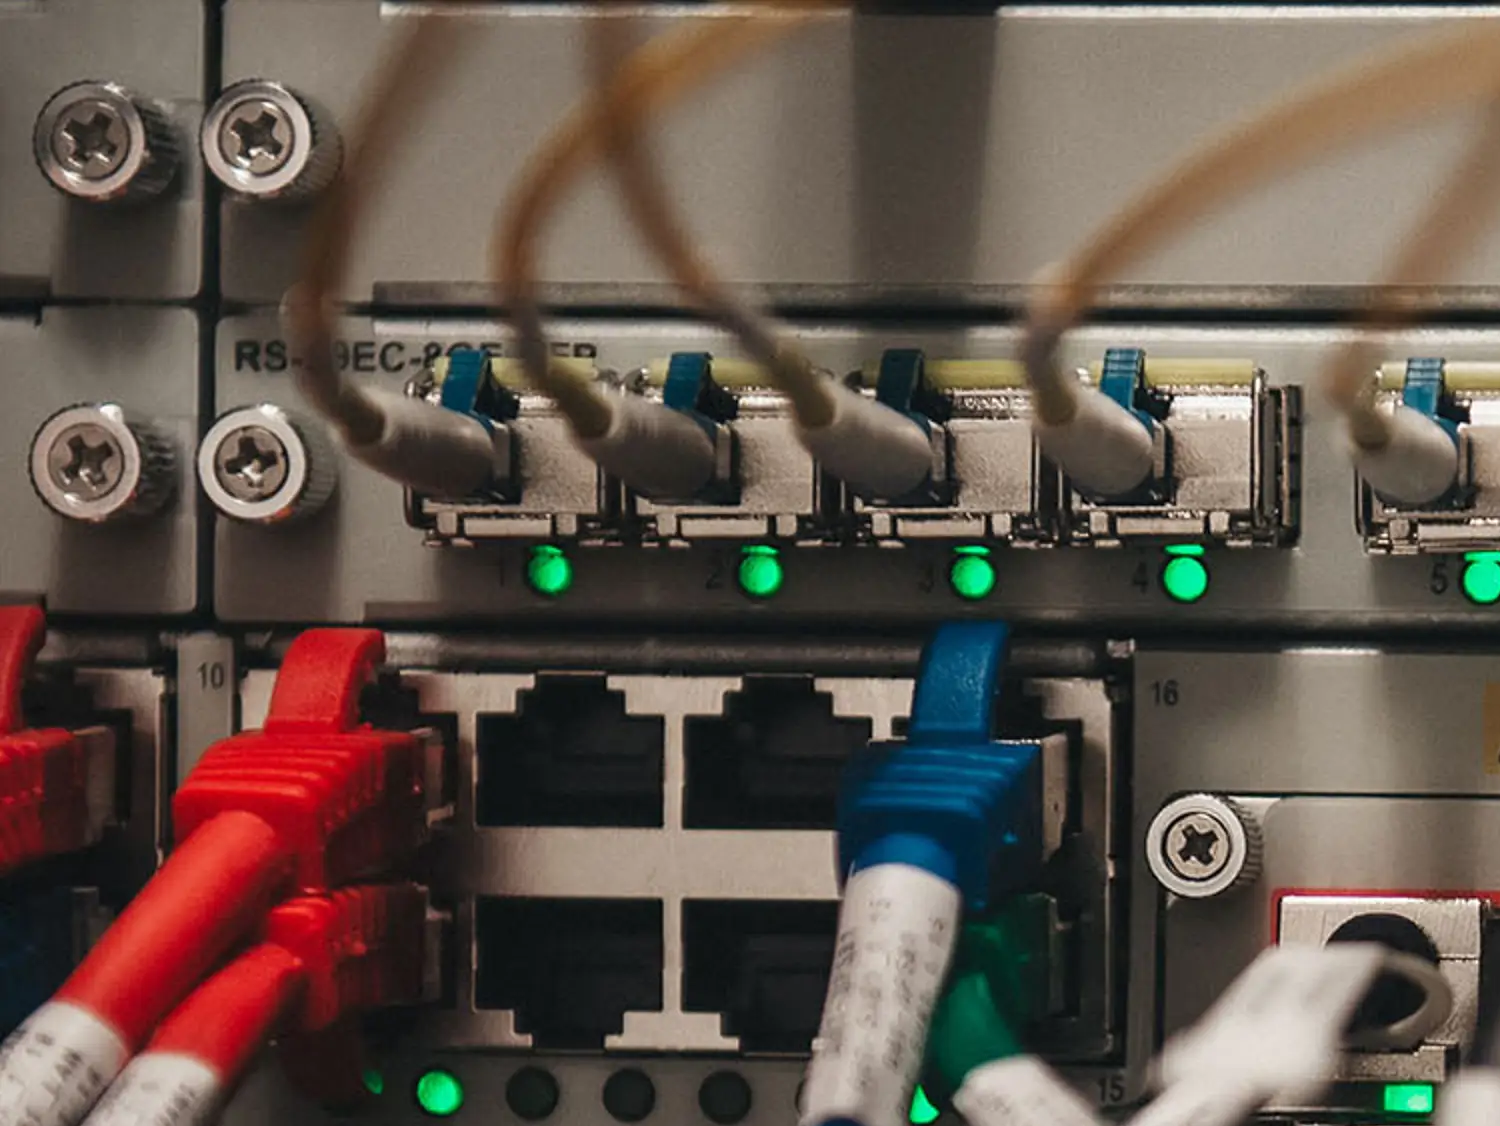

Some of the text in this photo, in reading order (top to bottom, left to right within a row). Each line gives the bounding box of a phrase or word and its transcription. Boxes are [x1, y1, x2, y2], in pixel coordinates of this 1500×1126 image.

[1131, 561, 1148, 594] 4
[1430, 564, 1448, 594] 5
[197, 661, 225, 690] 10
[1150, 679, 1179, 706] 16
[1098, 1075, 1124, 1103] 15
